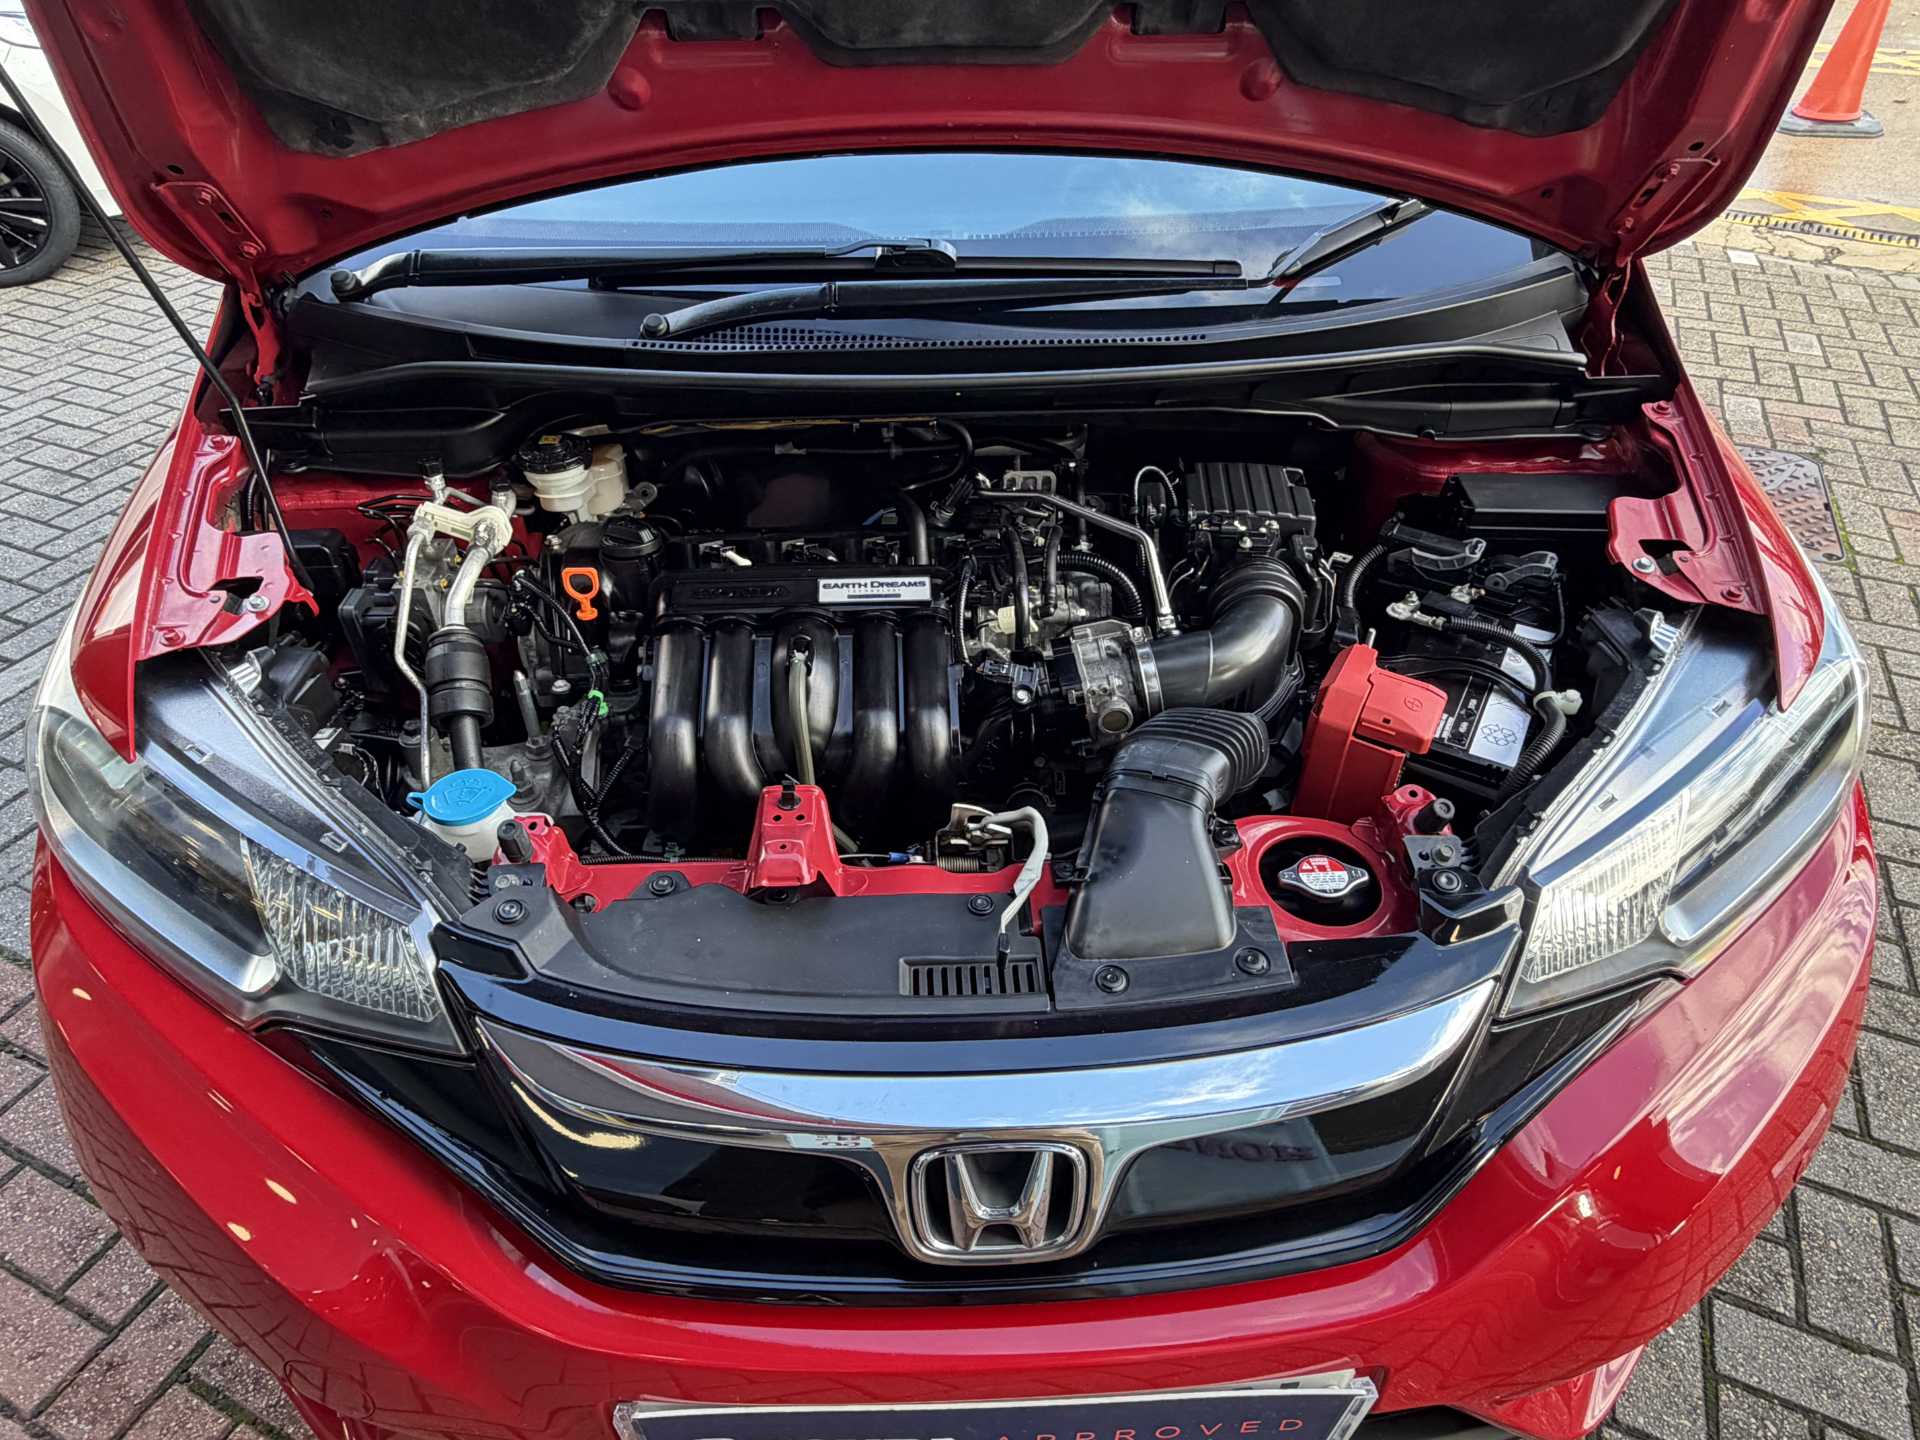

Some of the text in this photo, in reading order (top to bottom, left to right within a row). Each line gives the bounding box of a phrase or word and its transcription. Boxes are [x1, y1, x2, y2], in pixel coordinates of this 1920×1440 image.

[822, 580, 927, 590] EARTH DREAMS
[1000, 1418, 1304, 1440] PPROVED
